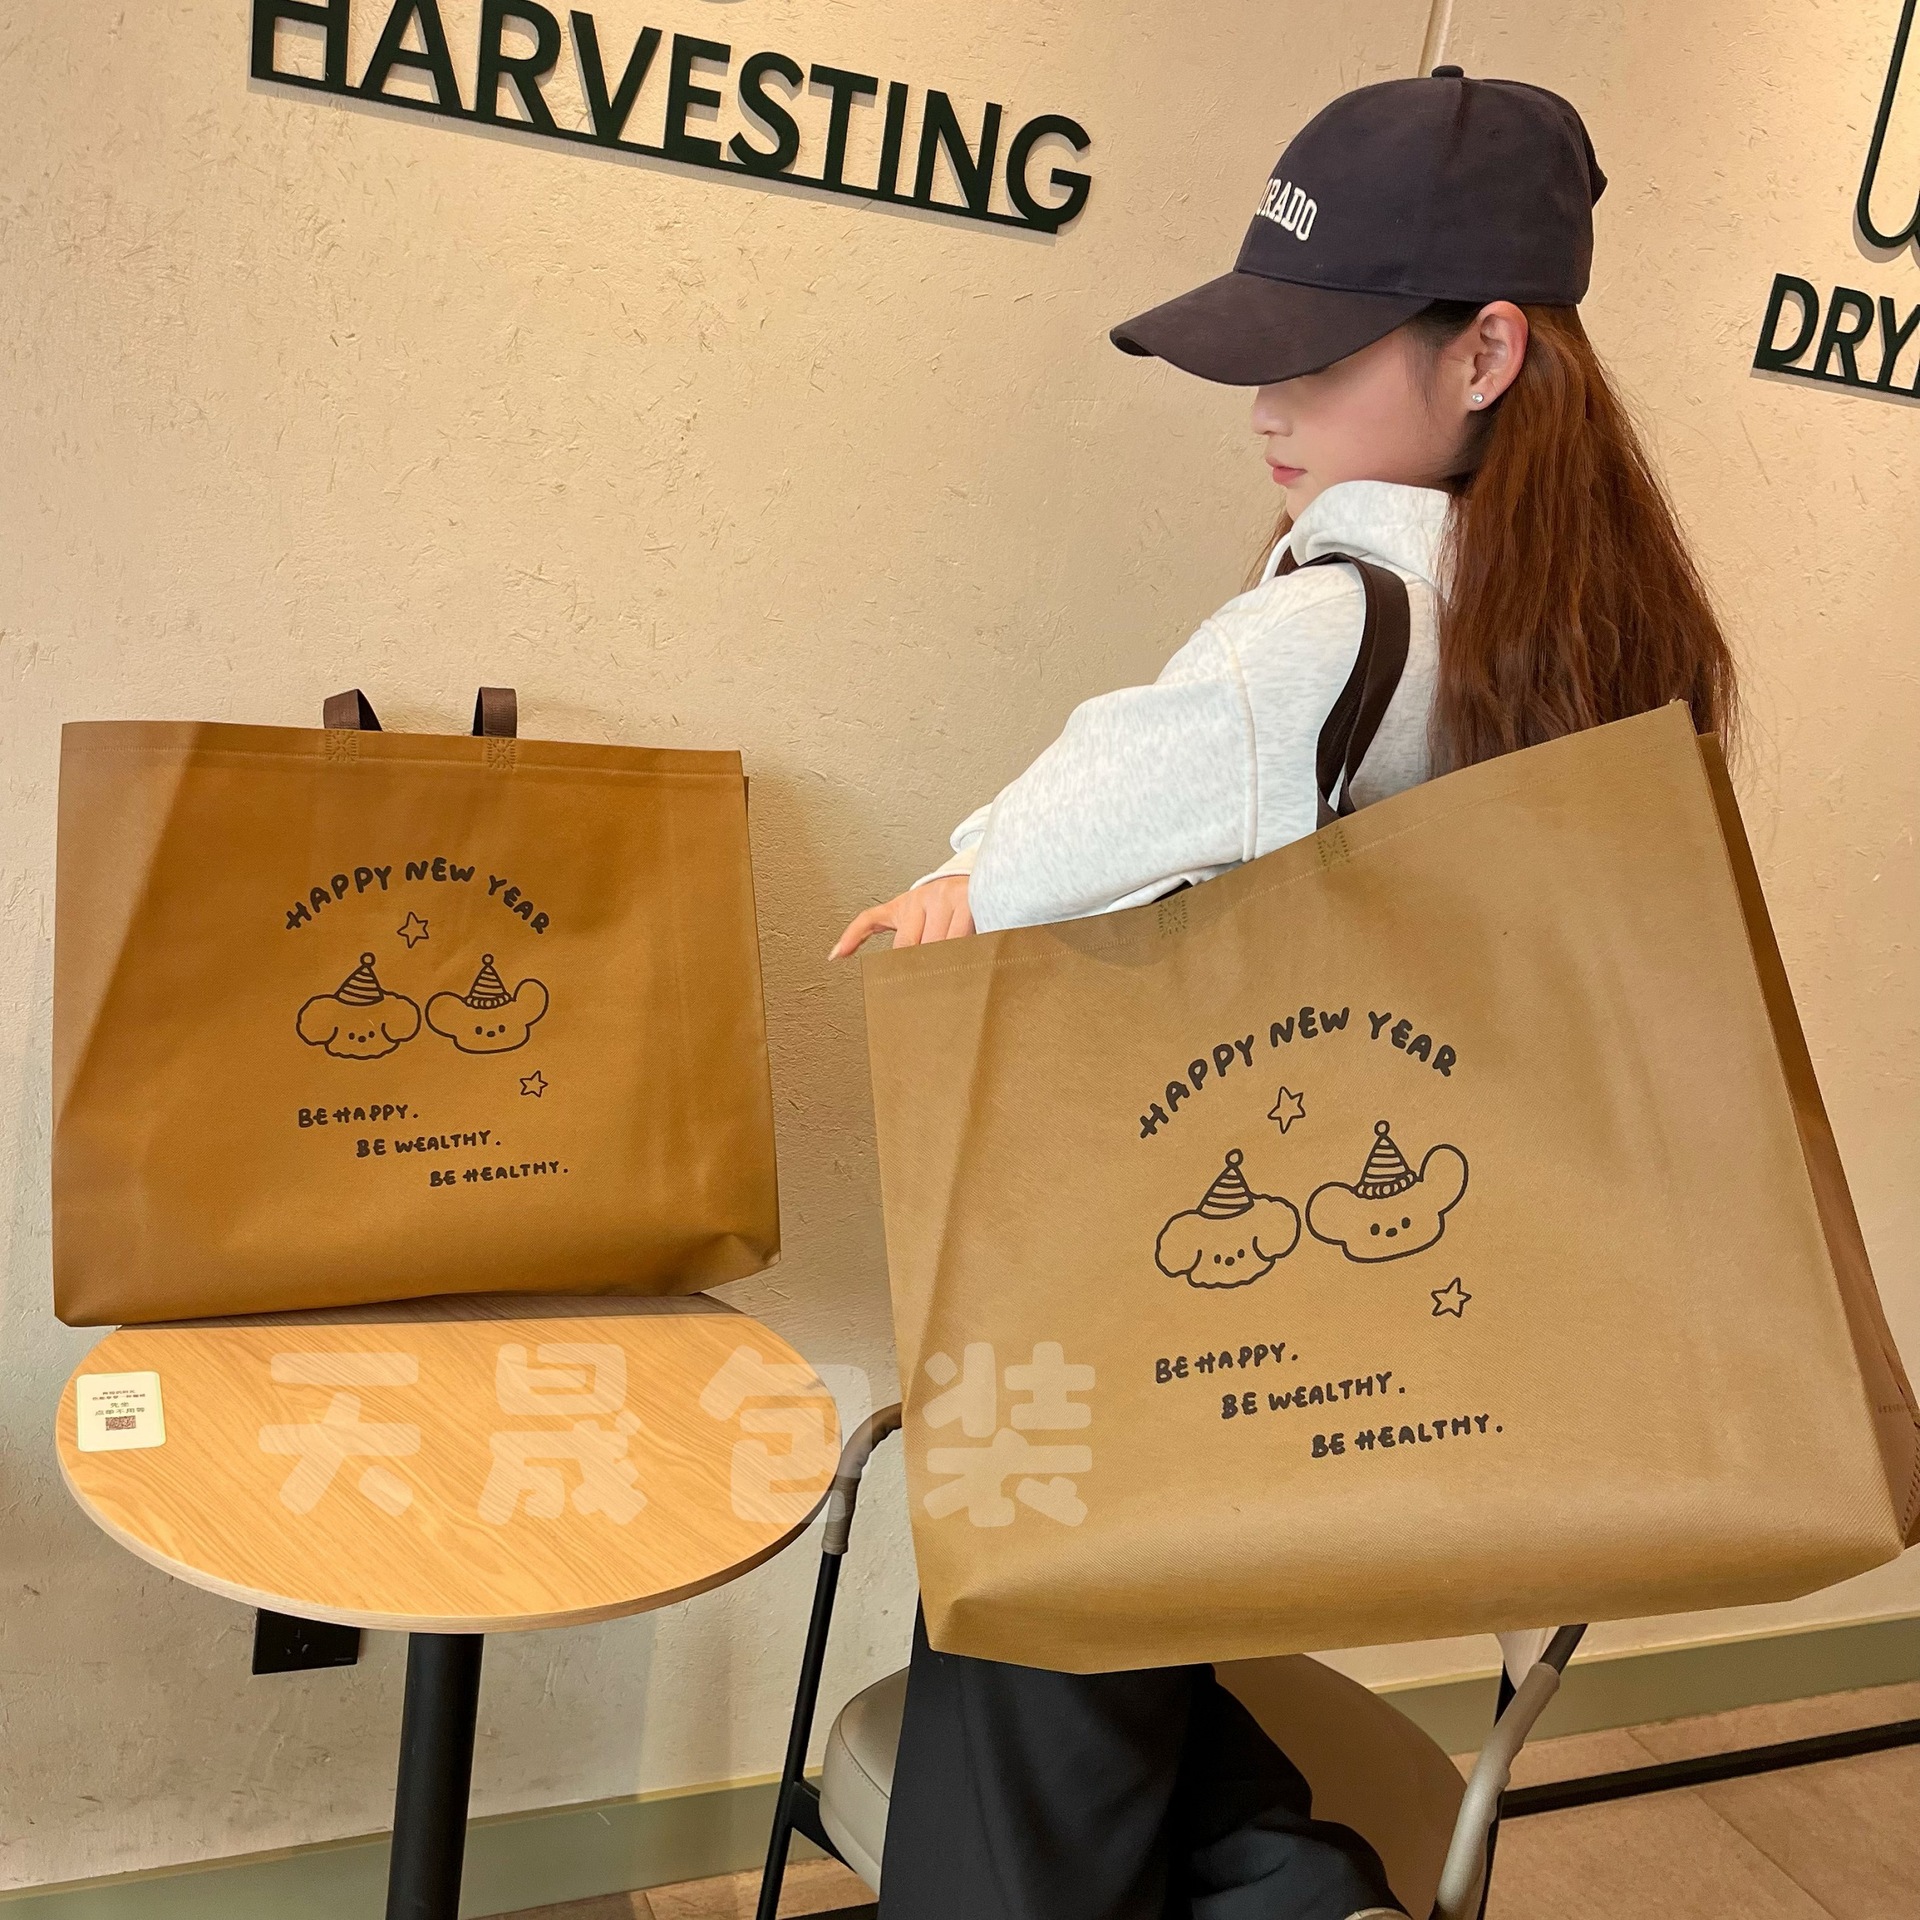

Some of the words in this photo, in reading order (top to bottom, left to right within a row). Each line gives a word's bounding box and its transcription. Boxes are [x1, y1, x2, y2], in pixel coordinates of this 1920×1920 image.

[251, 0, 1092, 234] HARVESTING
[1753, 273, 1920, 398] DRY
[286, 866, 391, 929] HAPPY
[406, 857, 475, 882] NEW
[489, 875, 549, 934] YEAR
[1140, 1035, 1254, 1138] HAPPY
[1270, 1007, 1349, 1047] NEW
[1369, 1011, 1456, 1077] YEAR
[299, 1108, 328, 1127] BE
[333, 1104, 418, 1123] HAPPY.
[357, 1139, 386, 1157] BE
[395, 1130, 500, 1153] WEALTHY.
[430, 1171, 456, 1187] BE
[463, 1161, 568, 1182] HEALTHY.
[1156, 1356, 1189, 1383] BE
[1194, 1343, 1298, 1373] HAPPY.
[1222, 1392, 1257, 1419] BE
[1268, 1372, 1405, 1411] WEALTHY.
[1312, 1433, 1345, 1458] BE
[1355, 1414, 1502, 1450] HEALTHY.
